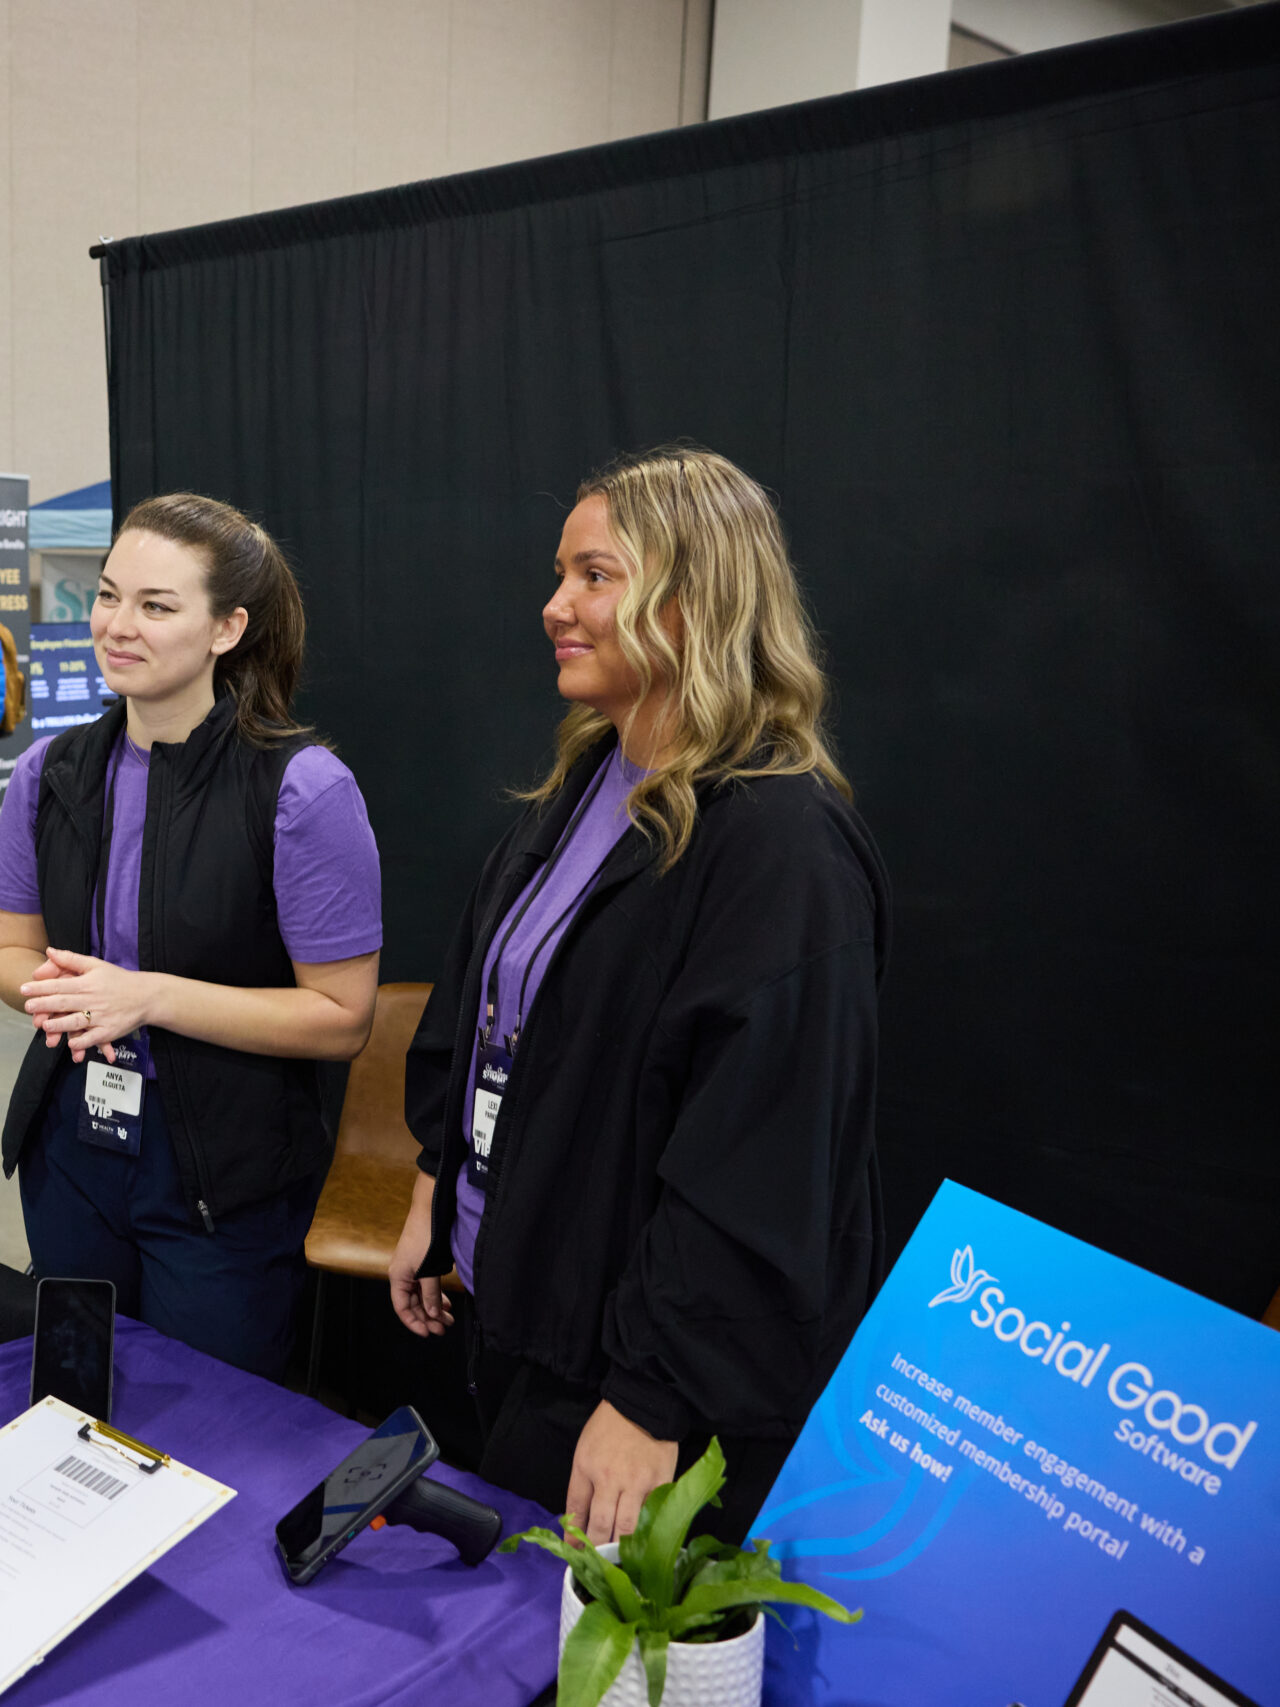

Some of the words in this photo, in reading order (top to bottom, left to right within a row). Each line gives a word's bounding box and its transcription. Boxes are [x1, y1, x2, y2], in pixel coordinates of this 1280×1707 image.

[88, 1102, 112, 1119] VIP
[105, 1071, 123, 1082] ANYA
[971, 1287, 1111, 1388] Social
[1107, 1362, 1258, 1470] Good
[859, 1409, 892, 1439] Ask
[888, 1430, 911, 1454] us
[910, 1441, 954, 1484] how!
[875, 1382, 962, 1448] customized
[958, 1438, 1067, 1520] membership
[1063, 1512, 1130, 1561] portal
[890, 1351, 955, 1405] Increase
[952, 1392, 1024, 1447] member
[1023, 1435, 1139, 1522] engagement
[1139, 1511, 1190, 1554] with
[1188, 1544, 1207, 1566] a
[1113, 1418, 1222, 1496] Software
